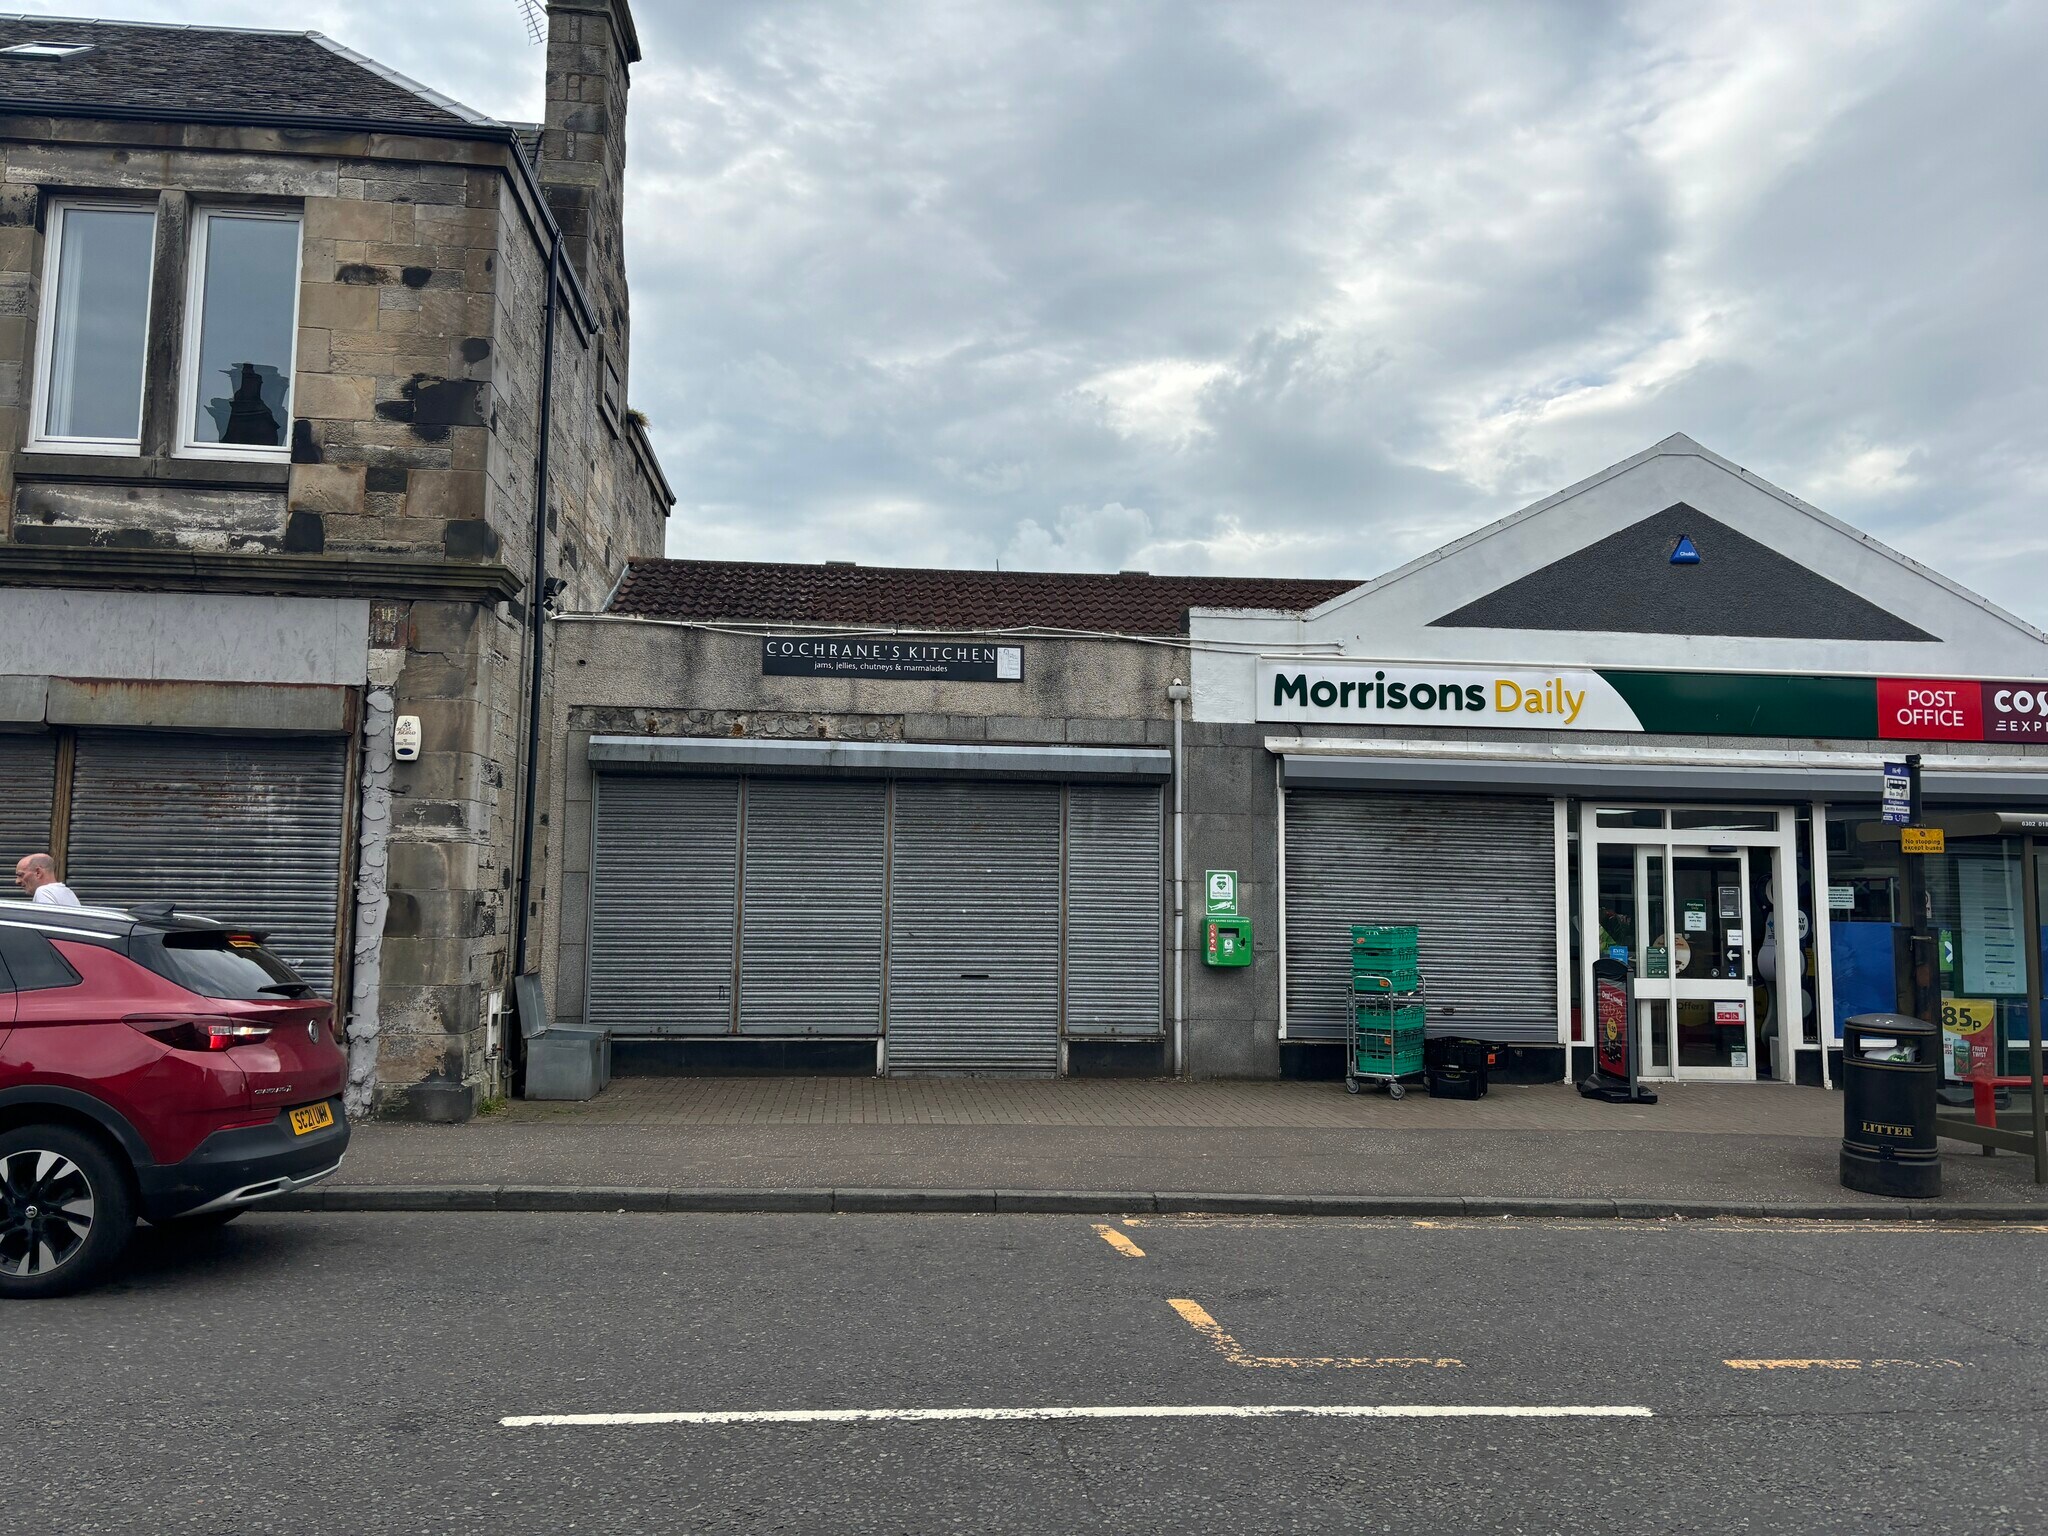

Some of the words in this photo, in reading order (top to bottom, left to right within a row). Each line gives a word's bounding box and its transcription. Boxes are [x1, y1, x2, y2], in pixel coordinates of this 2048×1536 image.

[766, 641, 900, 658] COCHRANE'S
[909, 646, 995, 660] KITCHEN
[814, 660, 834, 670] jams,
[835, 661, 858, 671] jellies,
[859, 662, 893, 672] chutneys
[903, 664, 948, 673] marmalades
[1273, 670, 1486, 711] Morrisons
[1495, 677, 1586, 725] Daily
[1908, 689, 1957, 707] POST
[1897, 708, 1965, 727] OFFICE
[2010, 720, 2048, 732] EXP
[1862, 1121, 1913, 1137] LITTER
